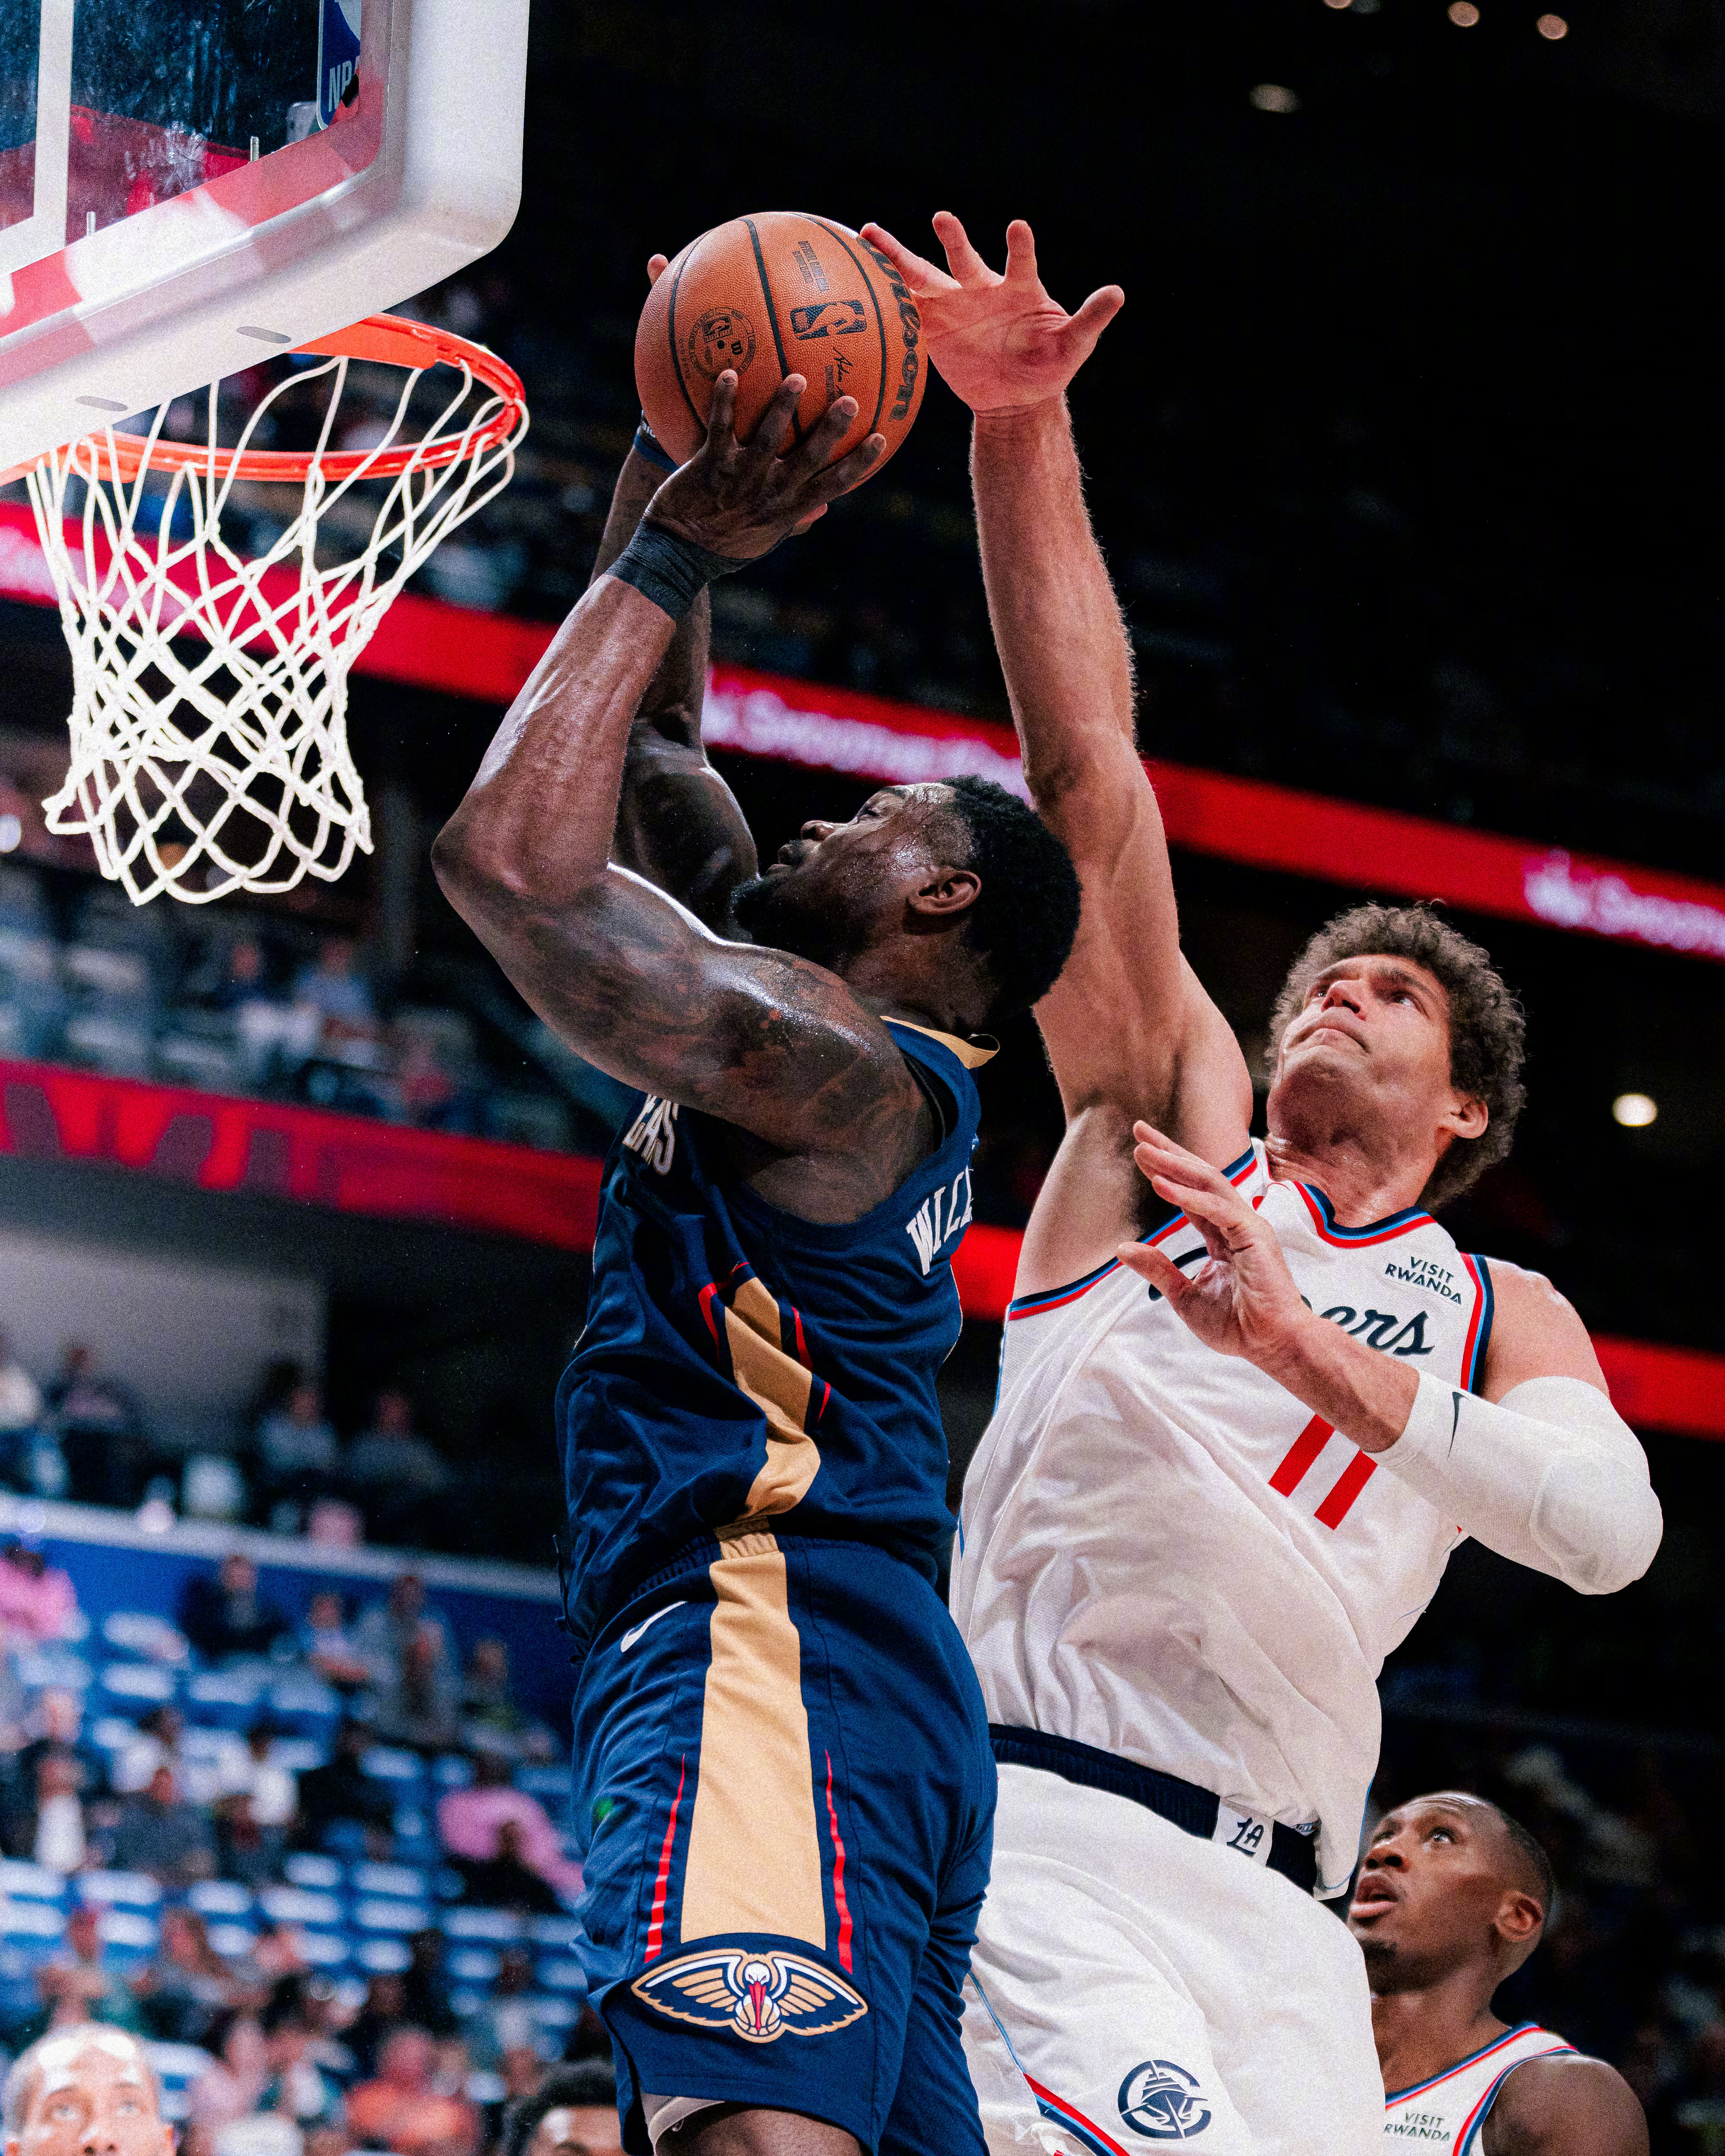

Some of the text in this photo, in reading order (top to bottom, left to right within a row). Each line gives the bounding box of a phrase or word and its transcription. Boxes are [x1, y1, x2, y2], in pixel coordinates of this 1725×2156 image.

[798, 240, 818, 262] OFFICIAL
[906, 1166, 972, 1275] WILL
[1384, 1263, 1462, 1305] RWANDA
[1411, 1256, 1454, 1284] VISIT
[1268, 1414, 1379, 1531] 11
[1226, 1817, 1264, 1858] LA
[1383, 2123, 1451, 2141] RWANDA
[1405, 2112, 1445, 2128] VISIT
